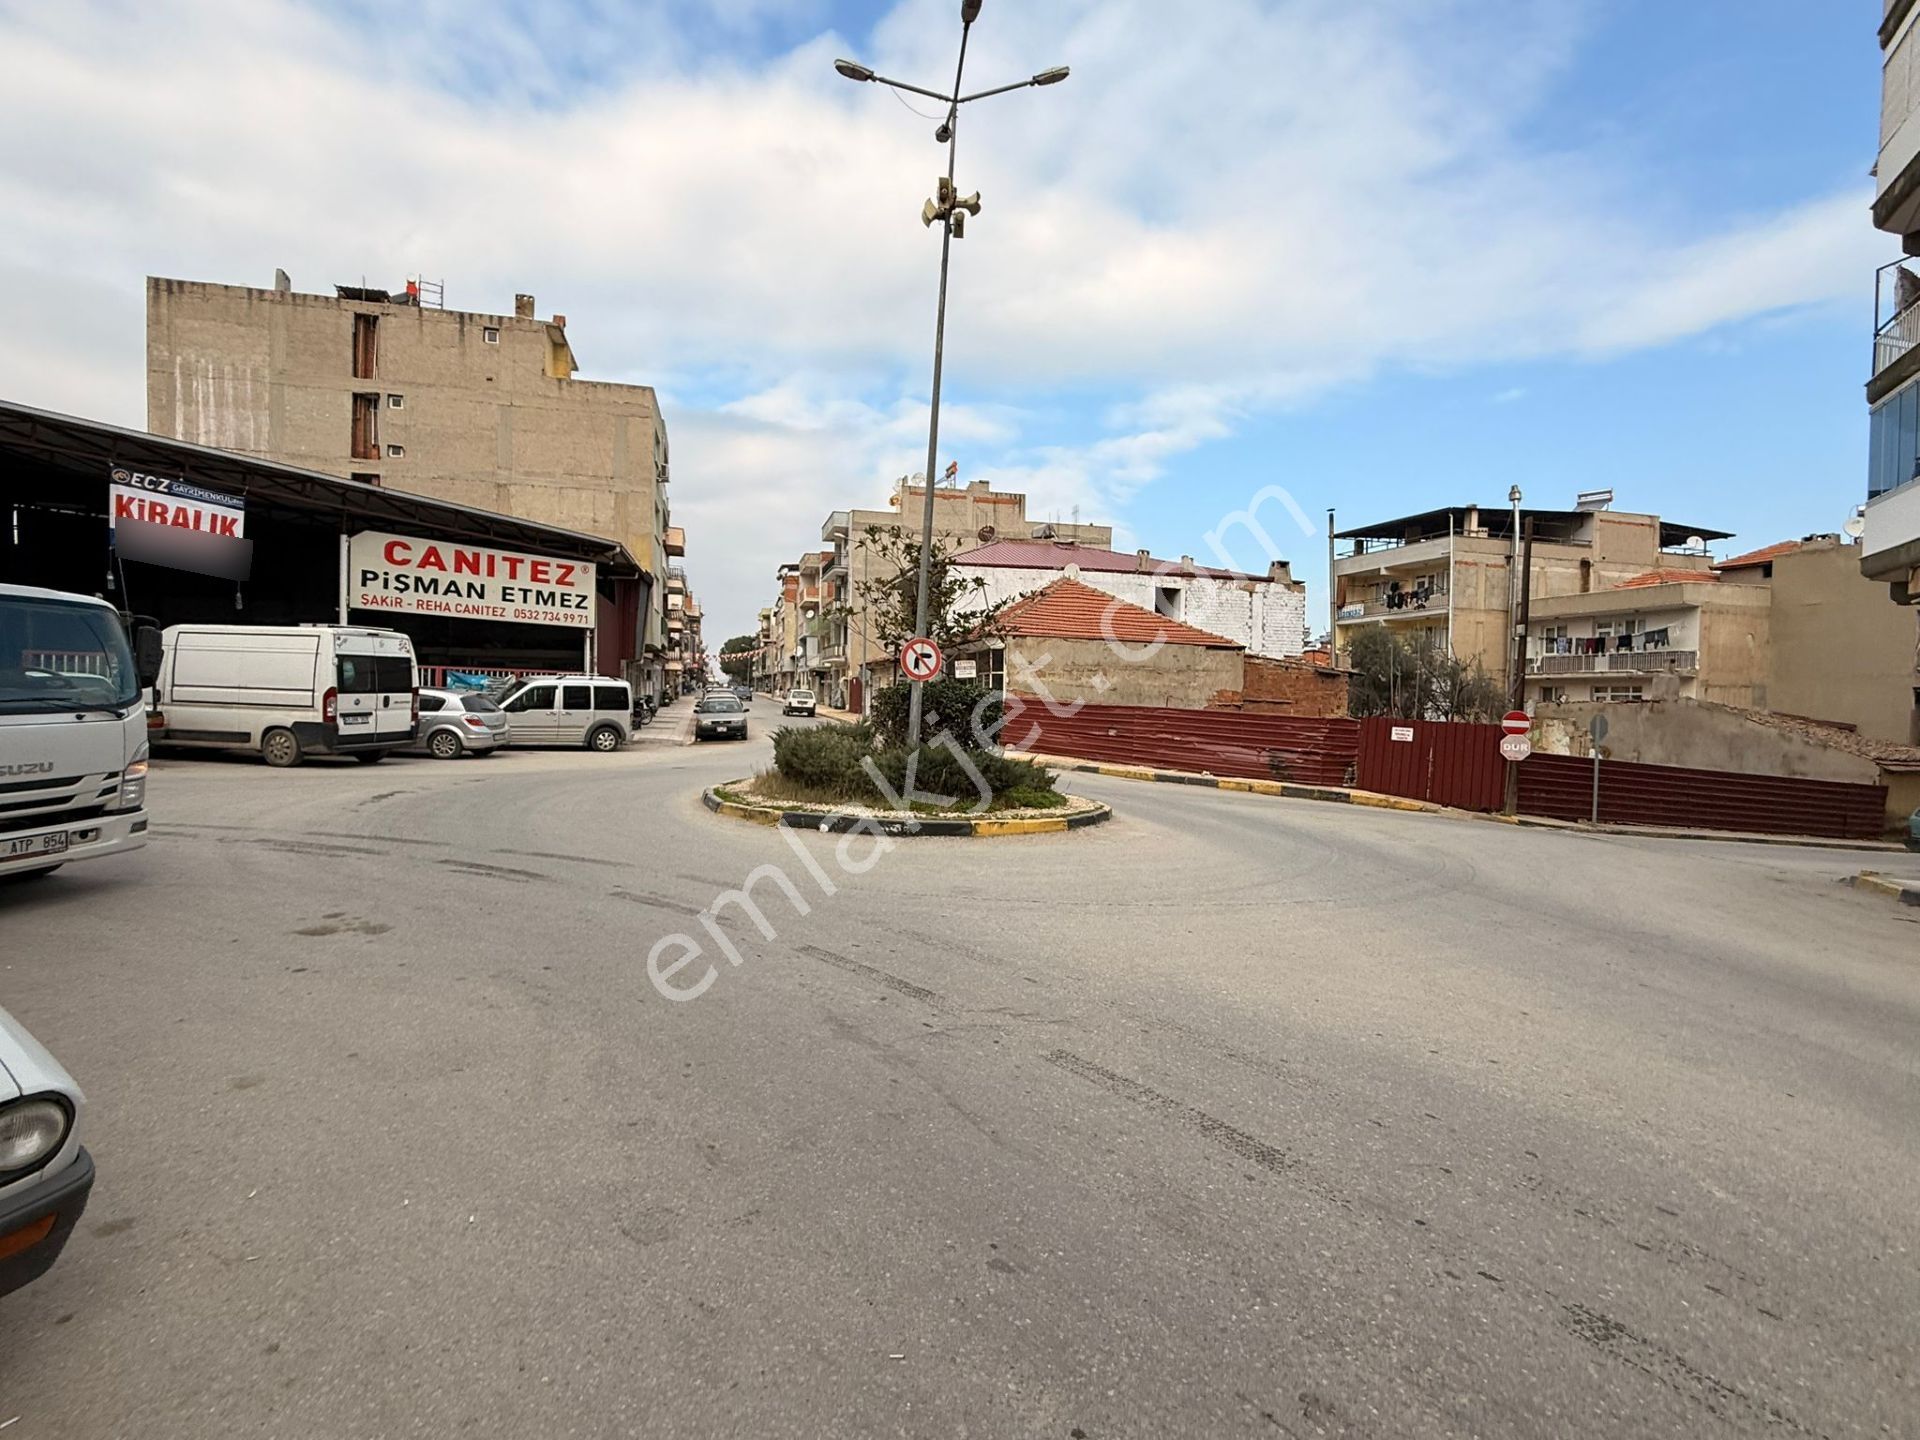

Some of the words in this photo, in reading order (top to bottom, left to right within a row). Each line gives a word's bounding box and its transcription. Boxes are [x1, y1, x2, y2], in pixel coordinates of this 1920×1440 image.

[131, 472, 170, 492] ECZ
[384, 540, 575, 587] CANITEZ
[502, 586, 588, 609] ETMEZ
[416, 599, 451, 612] REHA
[455, 603, 506, 617] CANITEZ
[514, 608, 540, 620] 0532
[542, 611, 560, 622] 734
[563, 613, 575, 623] 99
[577, 614, 589, 625] 71
[1503, 743, 1529, 751] DUR
[9, 839, 33, 854] ATP
[43, 834, 65, 849] 854
